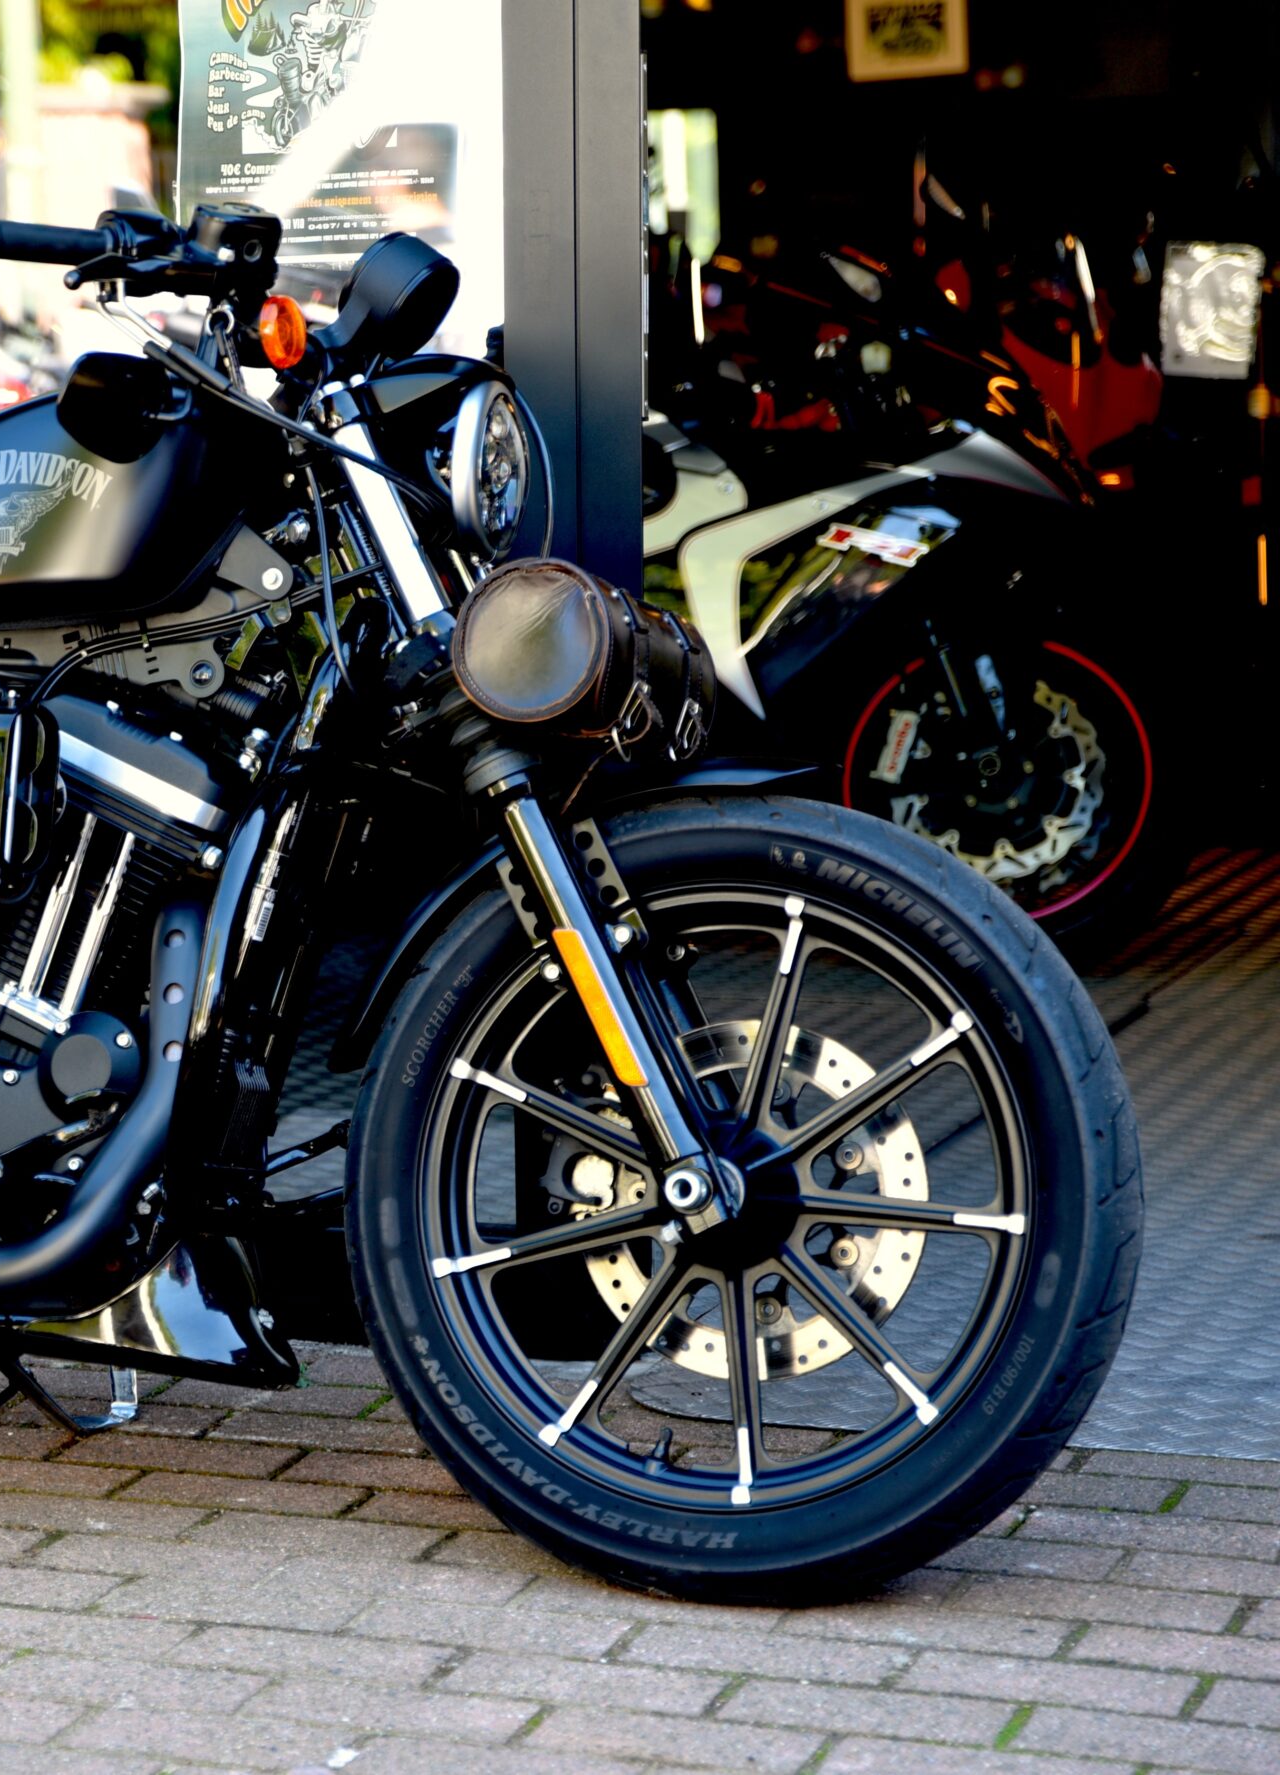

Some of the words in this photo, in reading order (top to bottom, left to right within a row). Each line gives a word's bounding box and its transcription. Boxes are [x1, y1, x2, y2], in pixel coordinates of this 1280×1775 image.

[208, 67, 251, 83] Barbecue
[207, 85, 225, 98] Bar
[207, 101, 230, 115] Jeux
[226, 114, 239, 129] de
[241, 109, 266, 120] camp
[220, 163, 241, 176] 40€
[816, 858, 983, 969] MICHELIN
[401, 990, 459, 1088] SCORCHER
[423, 1357, 739, 1550] HARLEY-DAVIDSON
